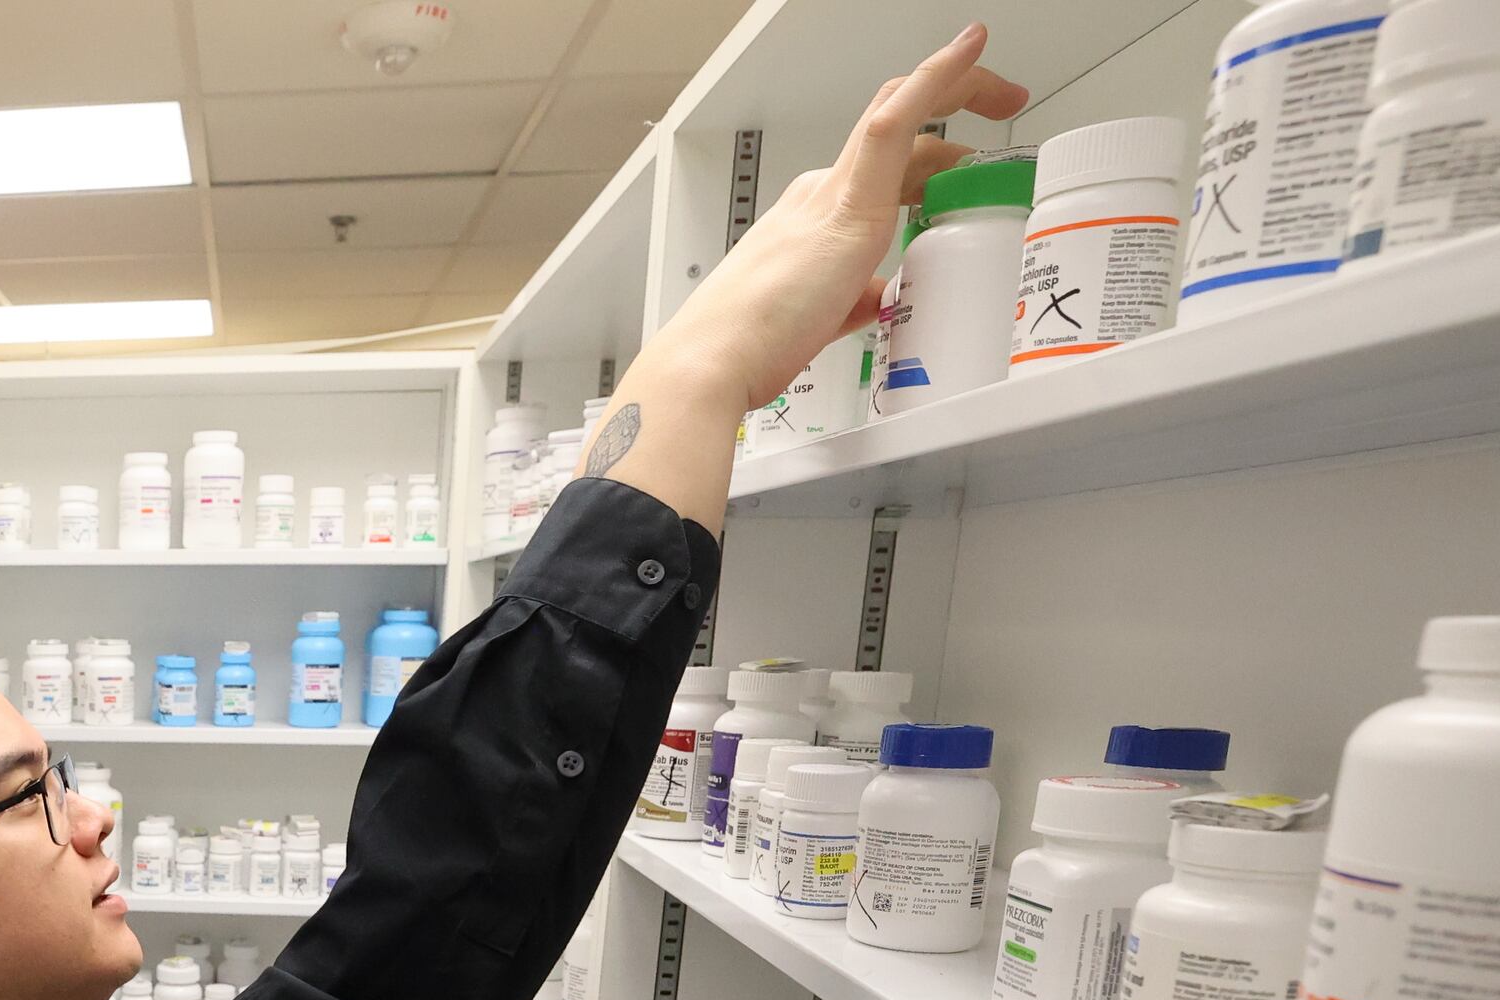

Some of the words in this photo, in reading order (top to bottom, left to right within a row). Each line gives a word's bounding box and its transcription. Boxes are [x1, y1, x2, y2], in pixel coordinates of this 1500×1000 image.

[1038, 277, 1059, 293] USP
[1046, 335, 1078, 345] Capsules
[794, 384, 814, 393] USP
[669, 756, 688, 766] Plus
[1006, 905, 1044, 929] PREZCOBIX
